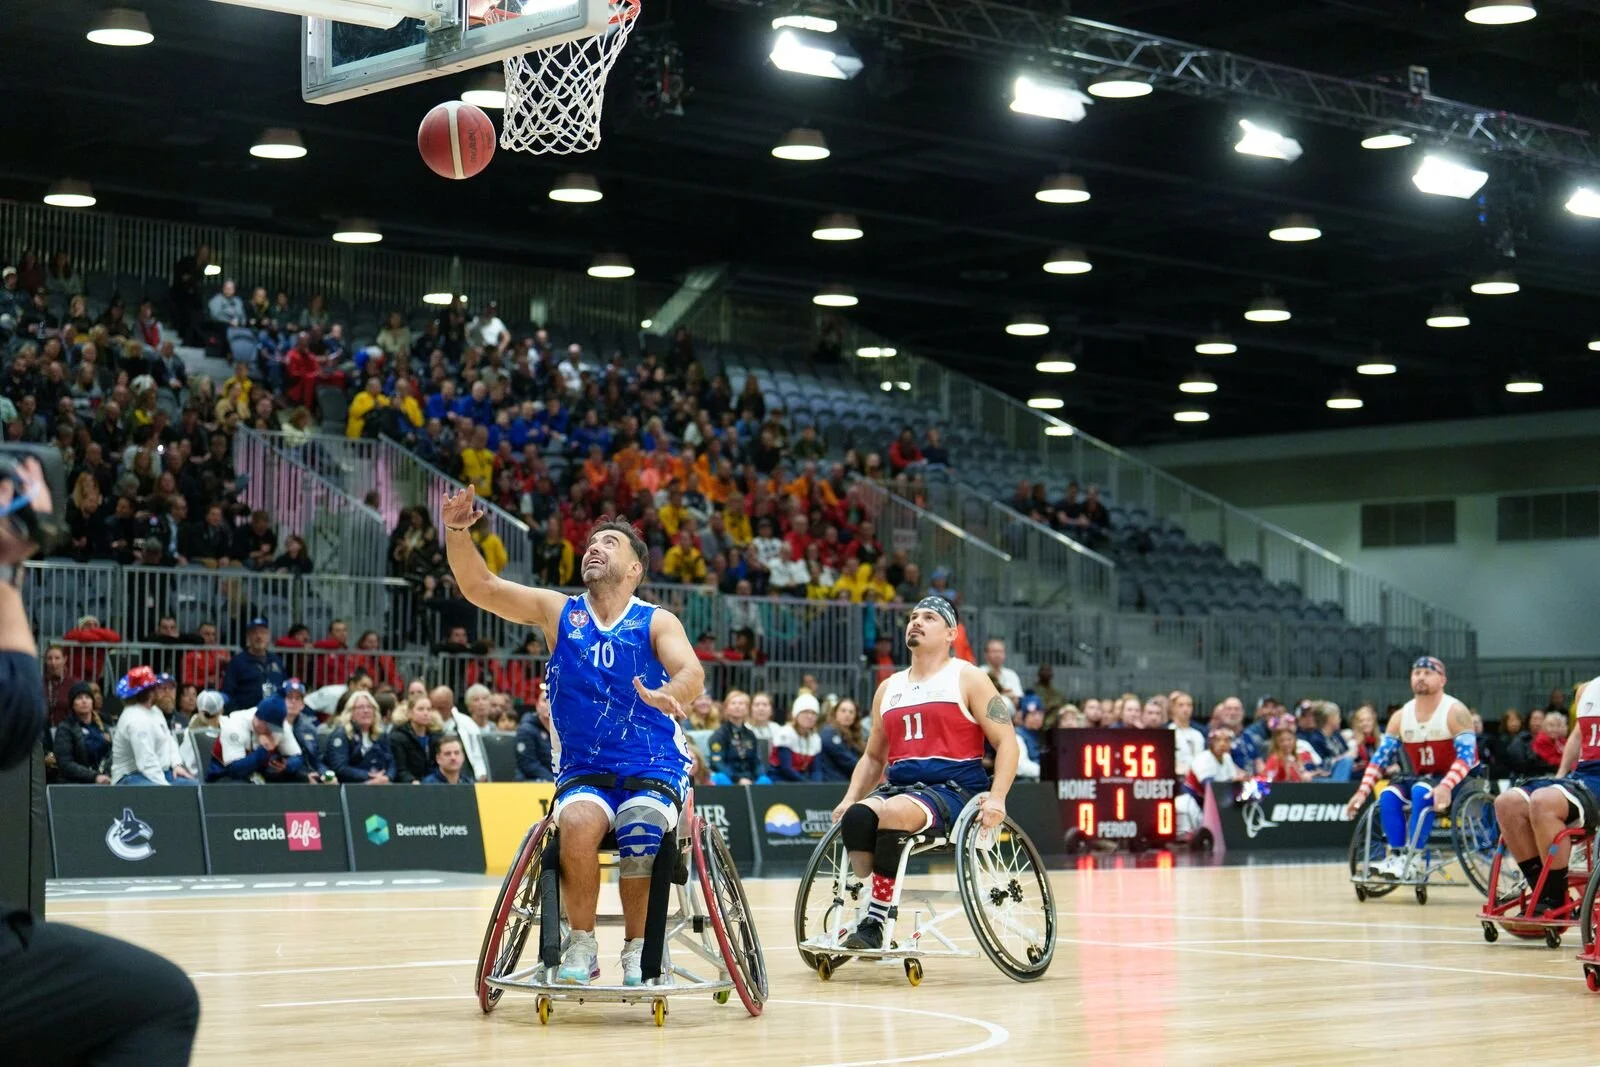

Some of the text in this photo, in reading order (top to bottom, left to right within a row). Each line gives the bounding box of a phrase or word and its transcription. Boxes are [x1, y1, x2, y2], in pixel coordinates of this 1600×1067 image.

[590, 641, 615, 668] 10
[902, 712, 924, 742] 11
[1084, 744, 1157, 778] 14:56
[1418, 745, 1435, 766] 13
[1058, 779, 1097, 800] HOME
[1133, 779, 1175, 800] GUEST
[1116, 787, 1125, 820] 1
[396, 823, 468, 839] Bennett Jones
[1097, 820, 1137, 838] PERIOD
[1158, 802, 1173, 834] 0
[233, 819, 321, 847] canada life
